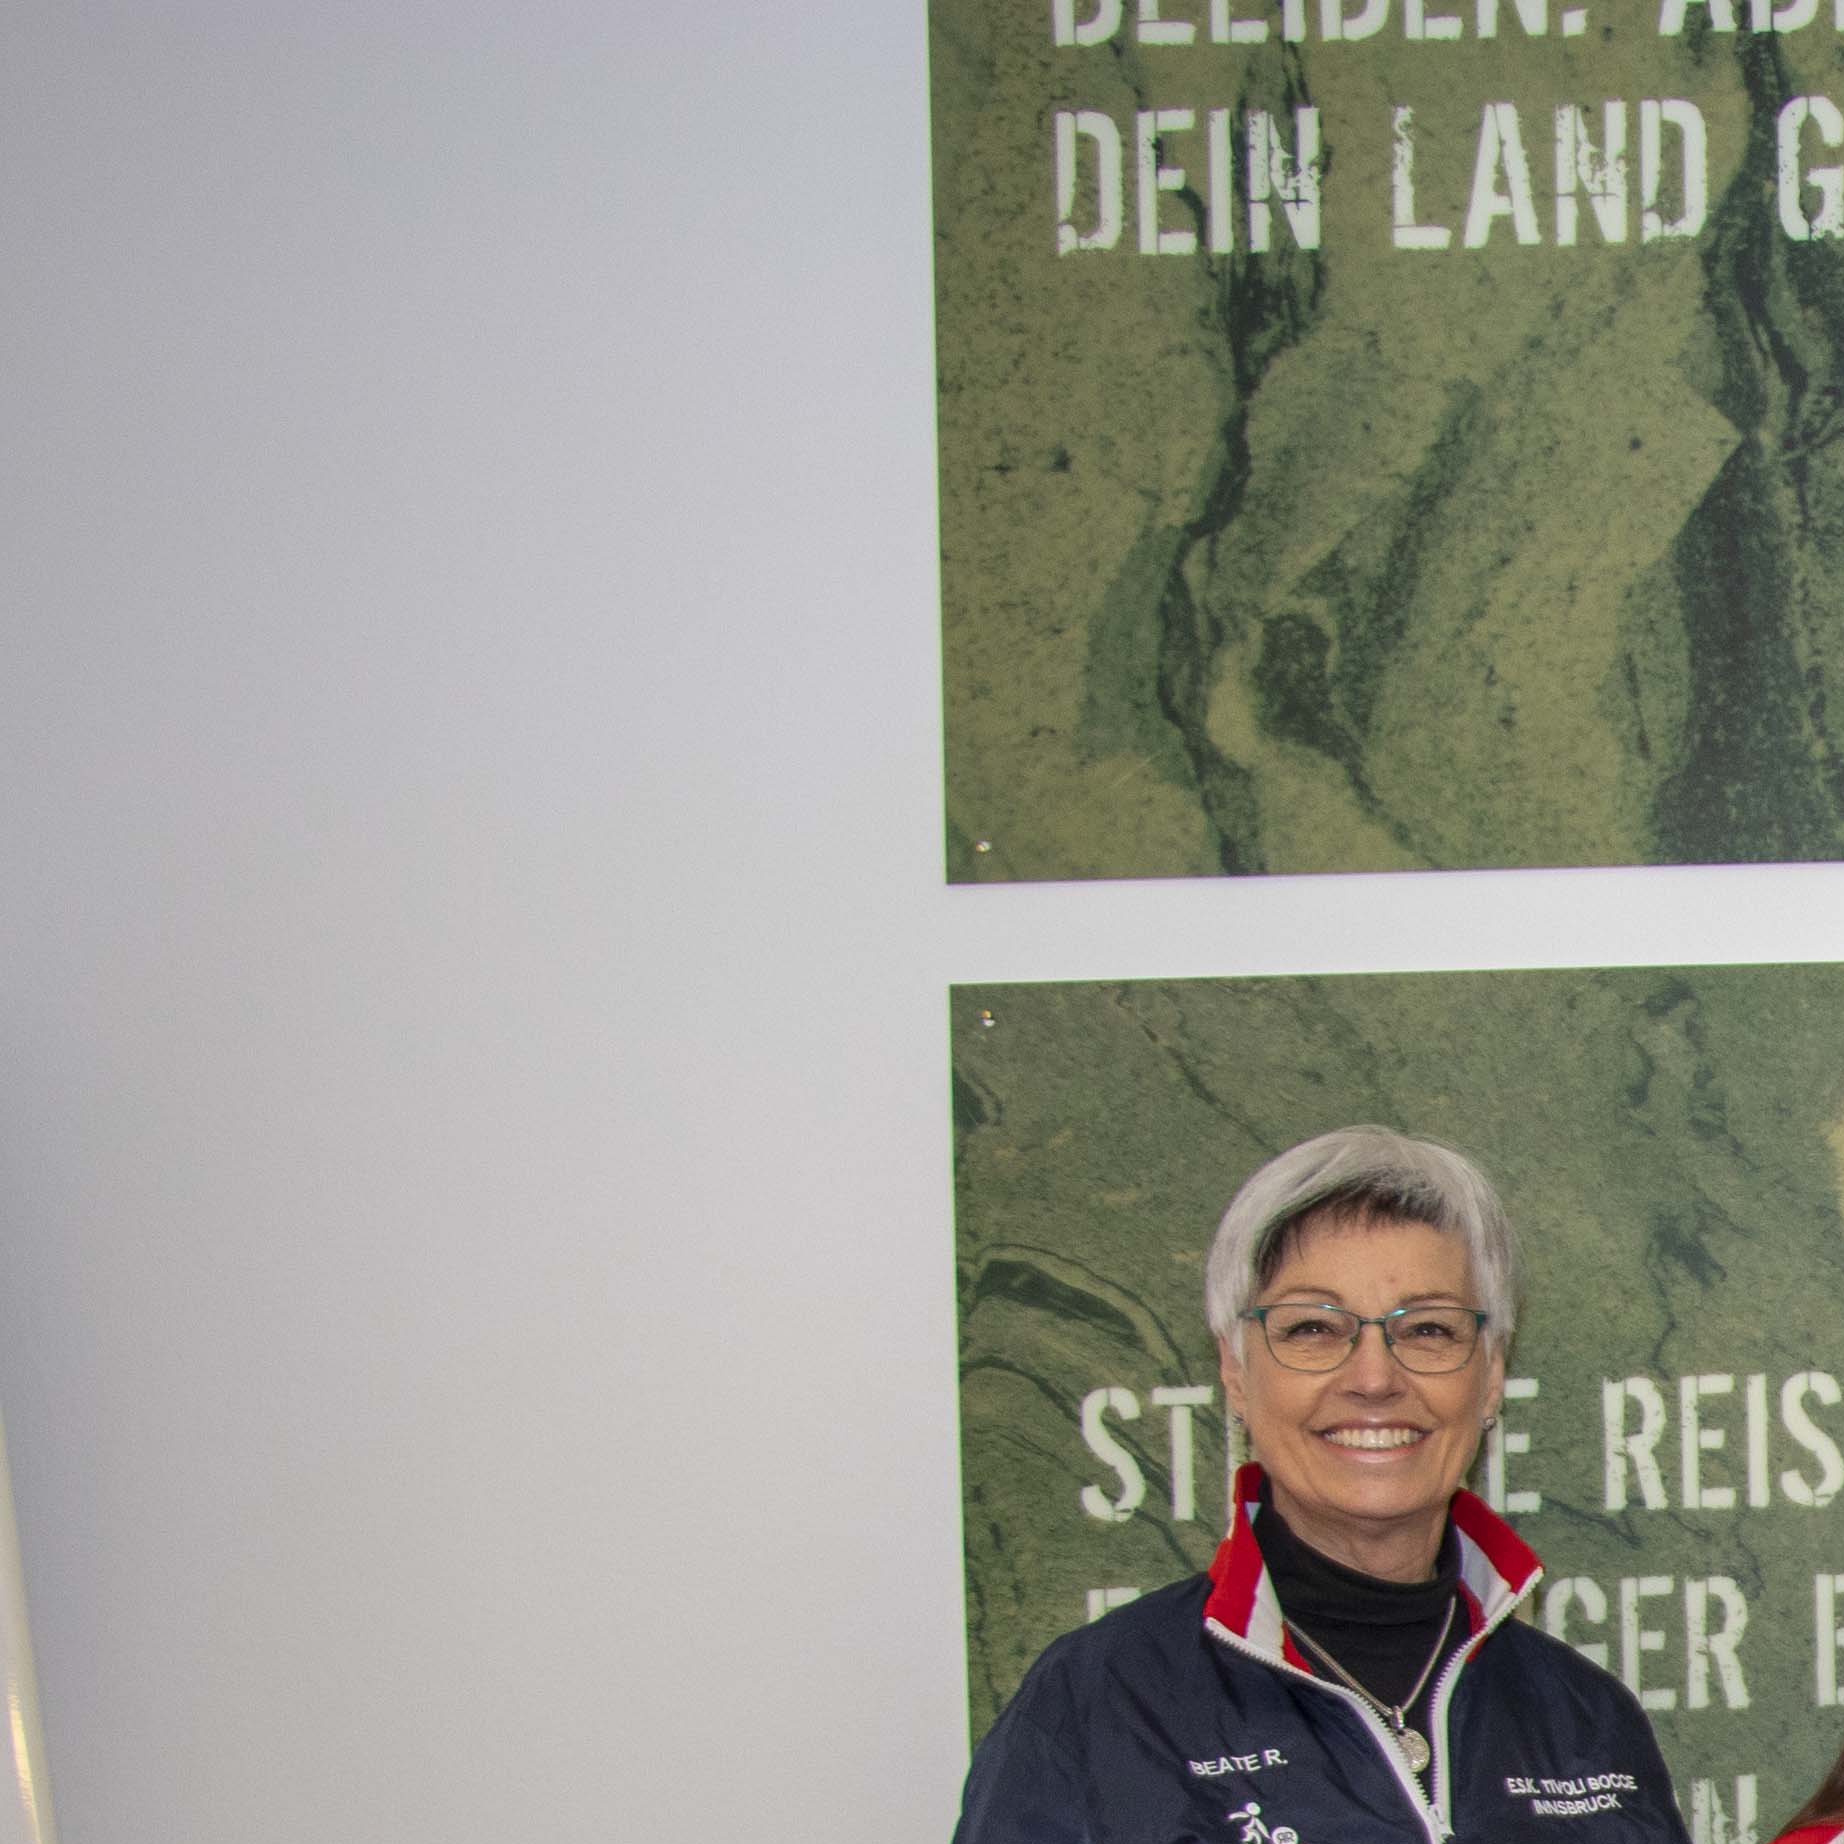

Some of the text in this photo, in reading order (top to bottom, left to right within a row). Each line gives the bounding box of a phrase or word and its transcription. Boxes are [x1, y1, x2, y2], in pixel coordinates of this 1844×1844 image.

[1054, 104, 1324, 257] DEIN
[1393, 97, 1708, 250] LAND
[1188, 1748, 1289, 1776] BEATE R.
[1540, 1777, 1587, 1796] TIVOLI
[1587, 1772, 1639, 1791] BOCCE
[1532, 1793, 1622, 1815] INNSBRUCK
